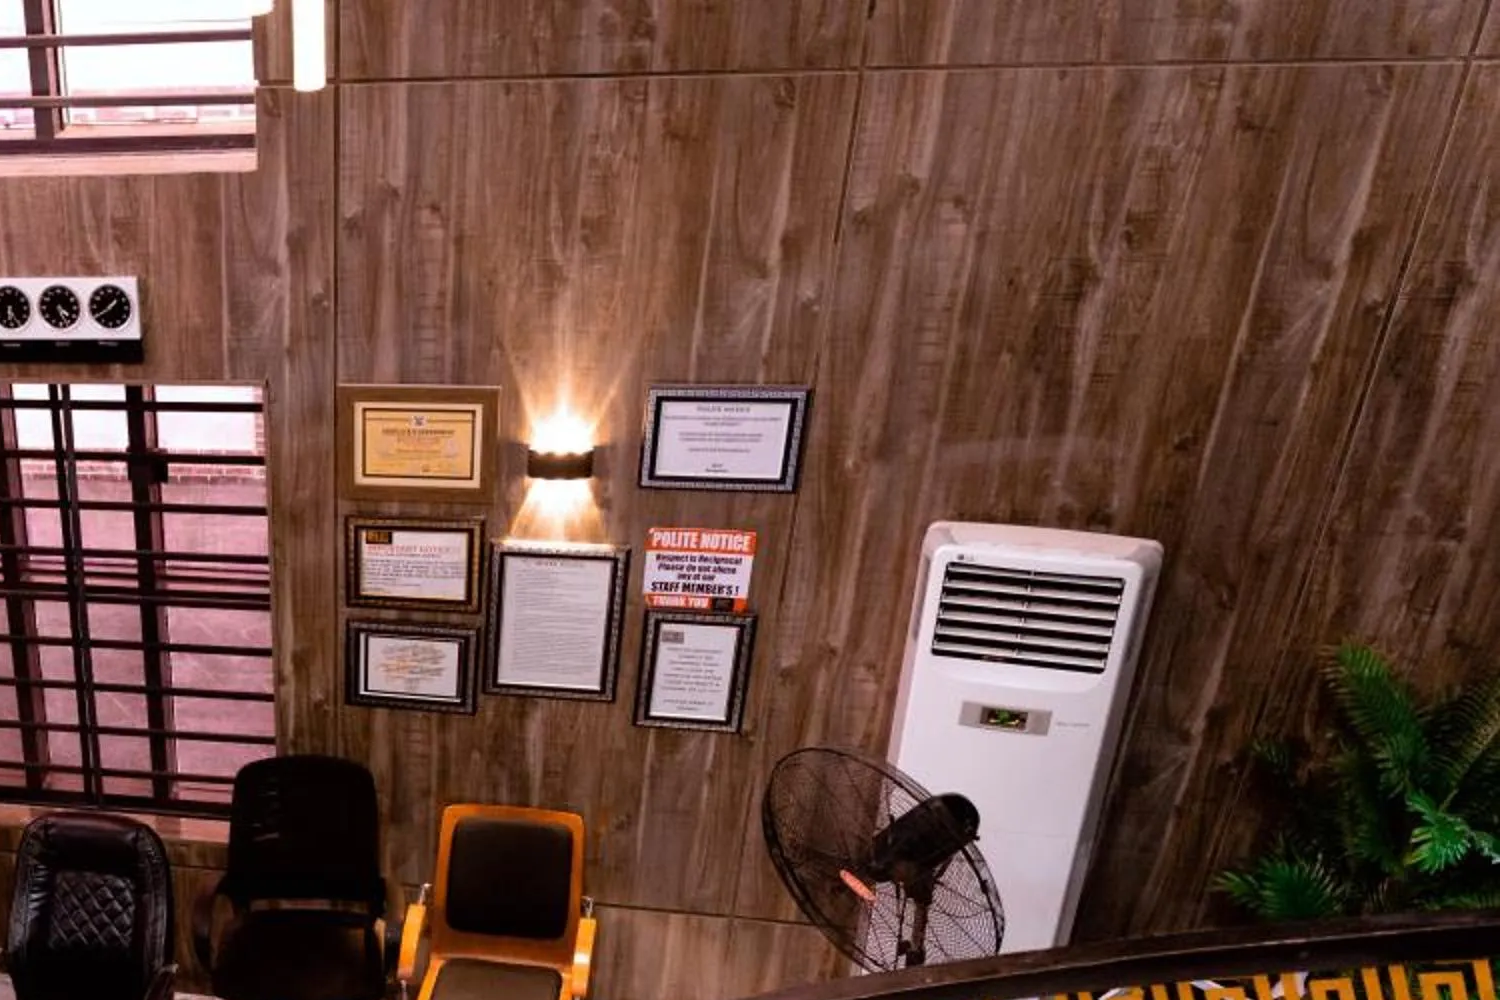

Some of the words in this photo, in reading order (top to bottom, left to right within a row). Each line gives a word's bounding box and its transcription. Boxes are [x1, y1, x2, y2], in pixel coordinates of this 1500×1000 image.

[652, 530, 699, 549] POLITE
[701, 532, 752, 552] NOTICE
[658, 563, 684, 572] Please
[651, 581, 680, 593] STAFF
[688, 597, 709, 608] YOU
